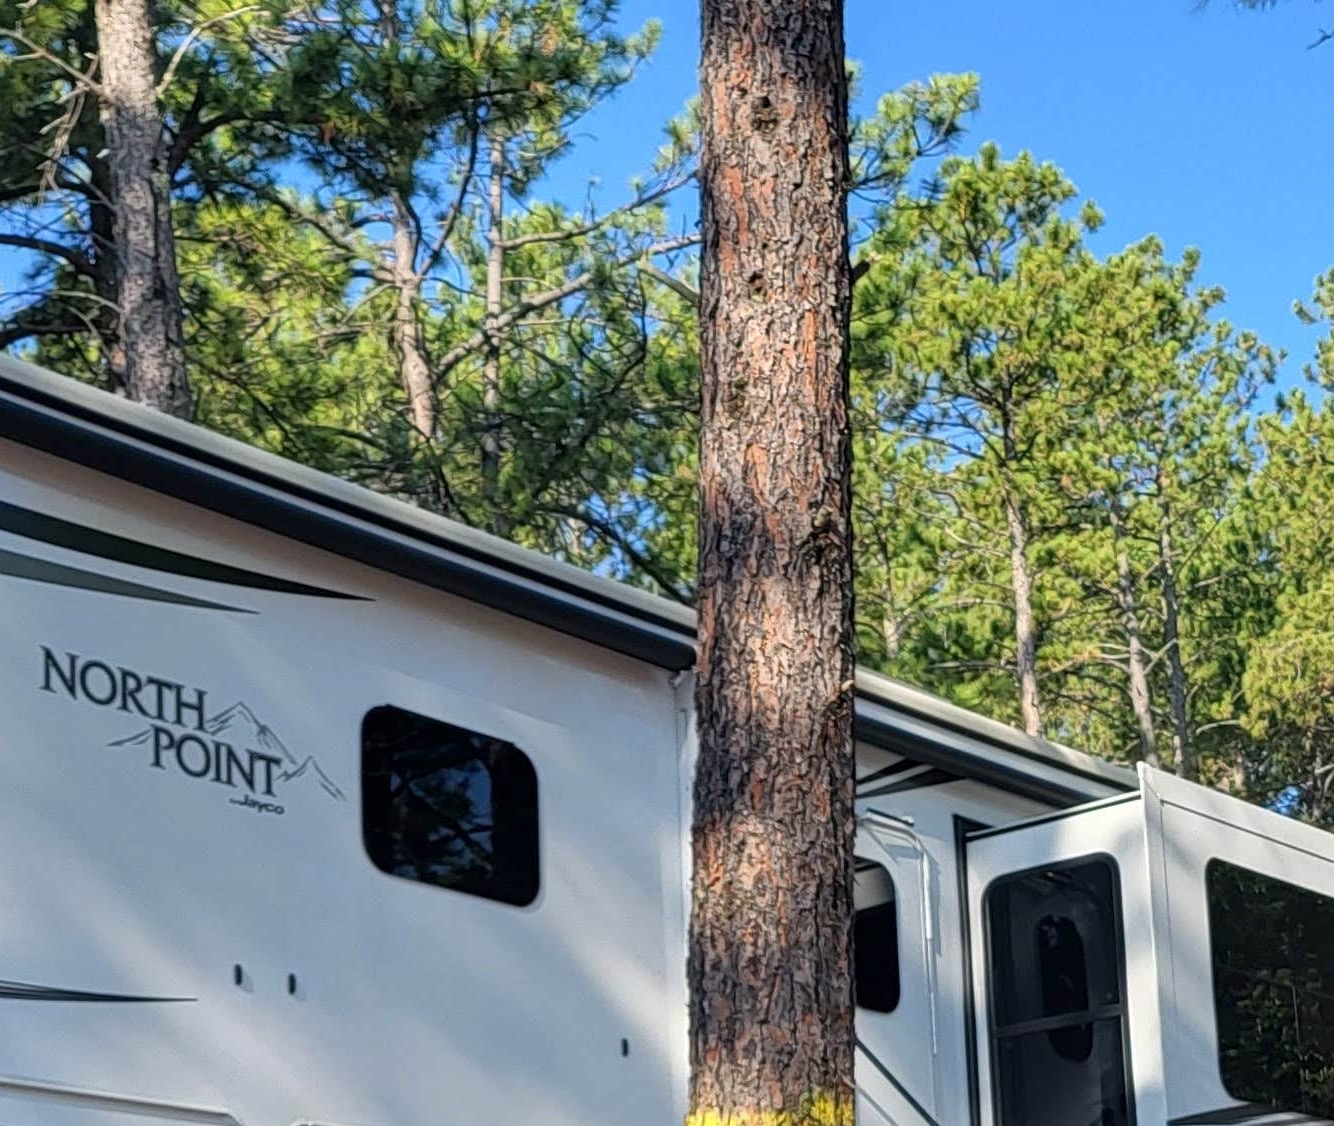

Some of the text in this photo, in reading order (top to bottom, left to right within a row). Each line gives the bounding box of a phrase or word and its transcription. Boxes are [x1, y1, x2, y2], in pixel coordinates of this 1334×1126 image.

[39, 644, 208, 733] NORTH
[149, 723, 283, 798] POINT
[229, 794, 285, 815] Jayco
